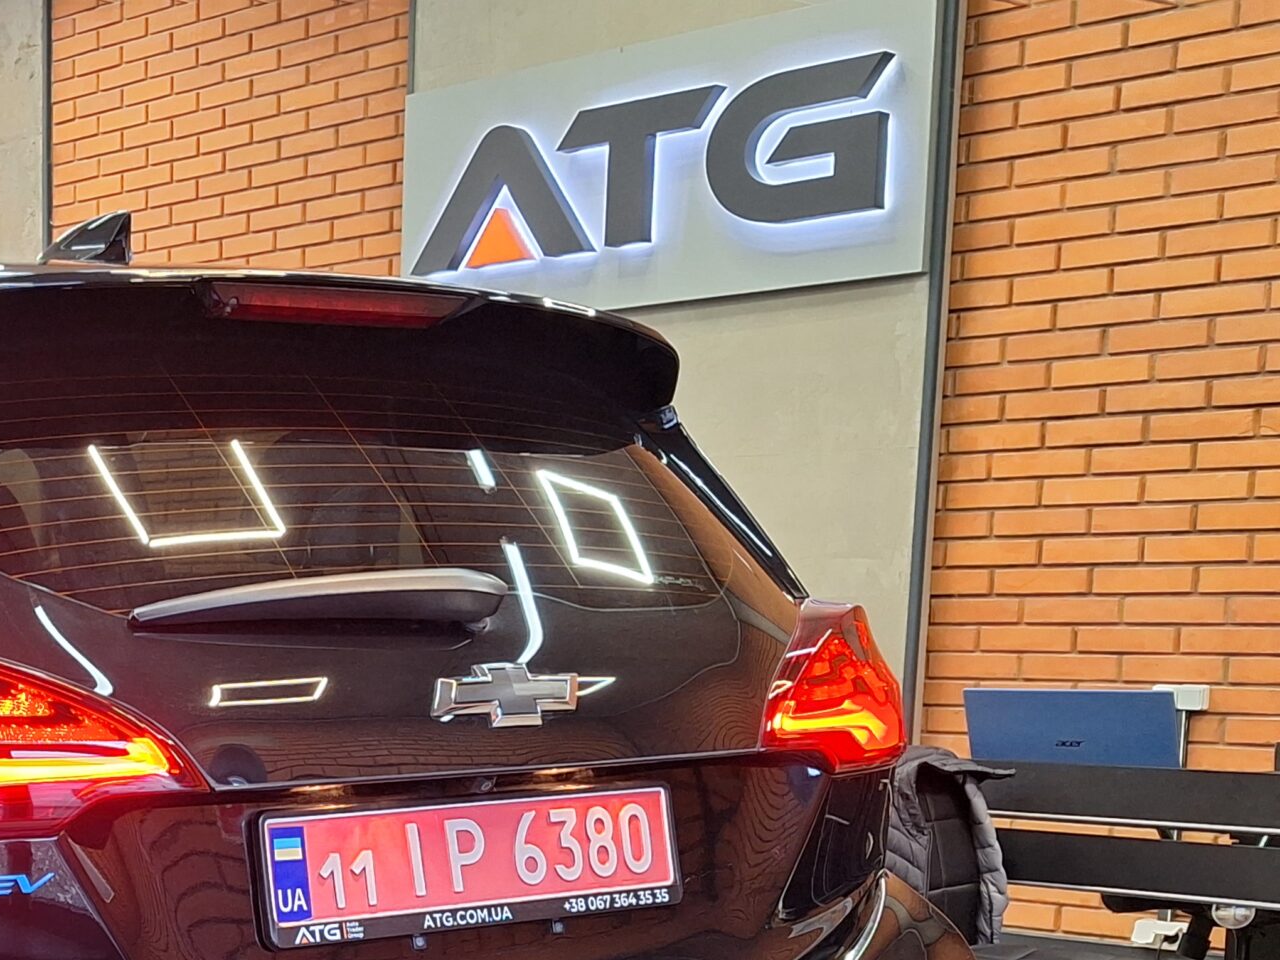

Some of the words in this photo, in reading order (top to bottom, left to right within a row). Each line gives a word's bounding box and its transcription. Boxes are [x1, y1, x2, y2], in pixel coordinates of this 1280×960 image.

[411, 50, 896, 275] ATG
[1055, 740, 1086, 748] acer
[320, 850, 377, 908] 11
[514, 802, 653, 885] 6380
[277, 888, 308, 912] UA
[563, 899, 586, 912] +38
[588, 896, 611, 910] 067
[613, 894, 638, 908] 364
[638, 891, 654, 904] 35
[655, 889, 670, 903] 35
[423, 907, 513, 929] ATG.COM.UA
[294, 923, 342, 945] ATG
